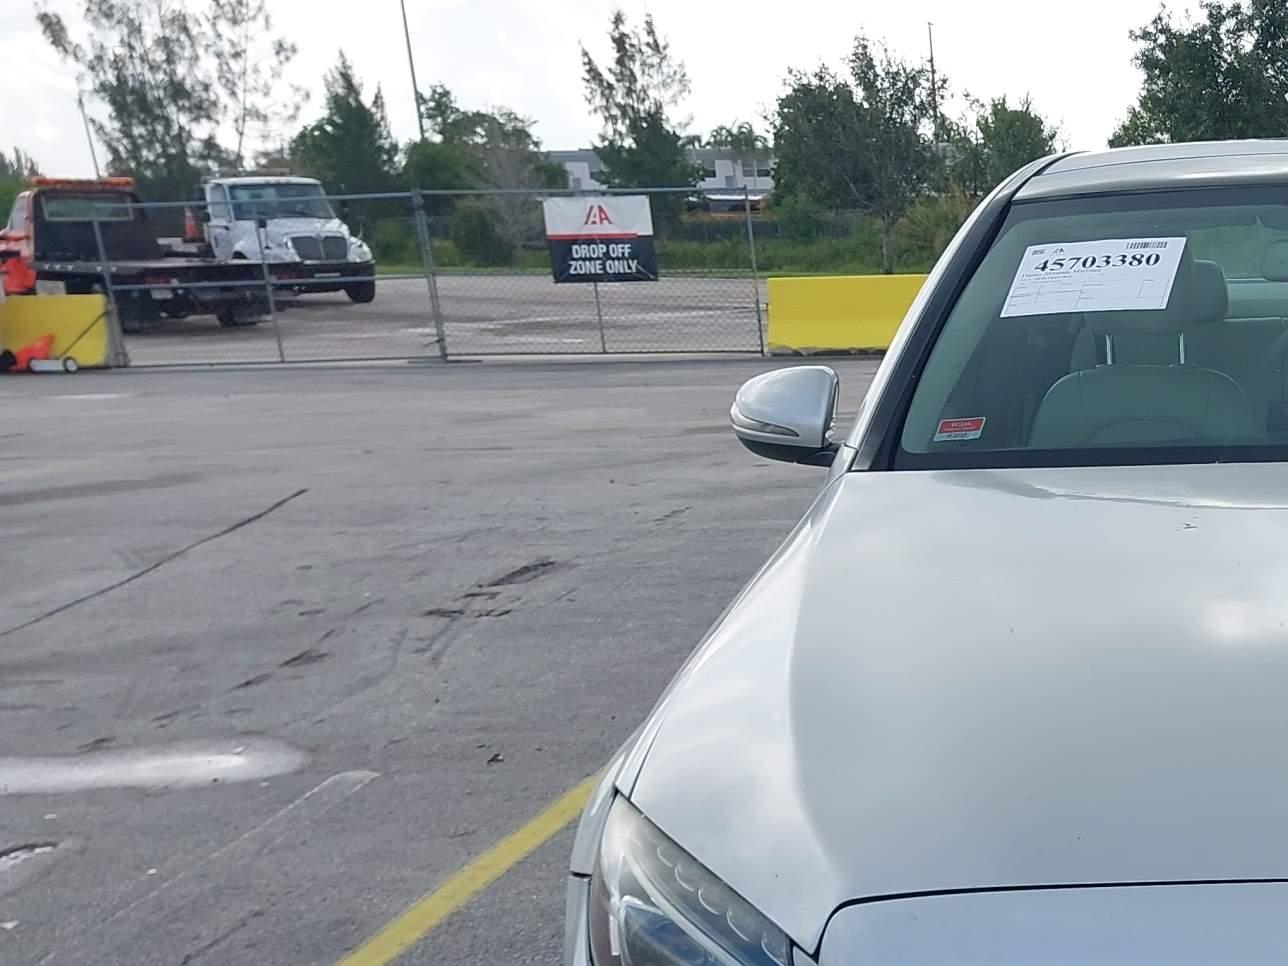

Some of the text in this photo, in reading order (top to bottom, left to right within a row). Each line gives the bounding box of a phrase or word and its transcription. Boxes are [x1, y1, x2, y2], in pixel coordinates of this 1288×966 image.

[572, 244, 632, 258] DROP OFF
[569, 260, 638, 275] ZONE ONLY
[1034, 253, 1161, 272] 45703380
